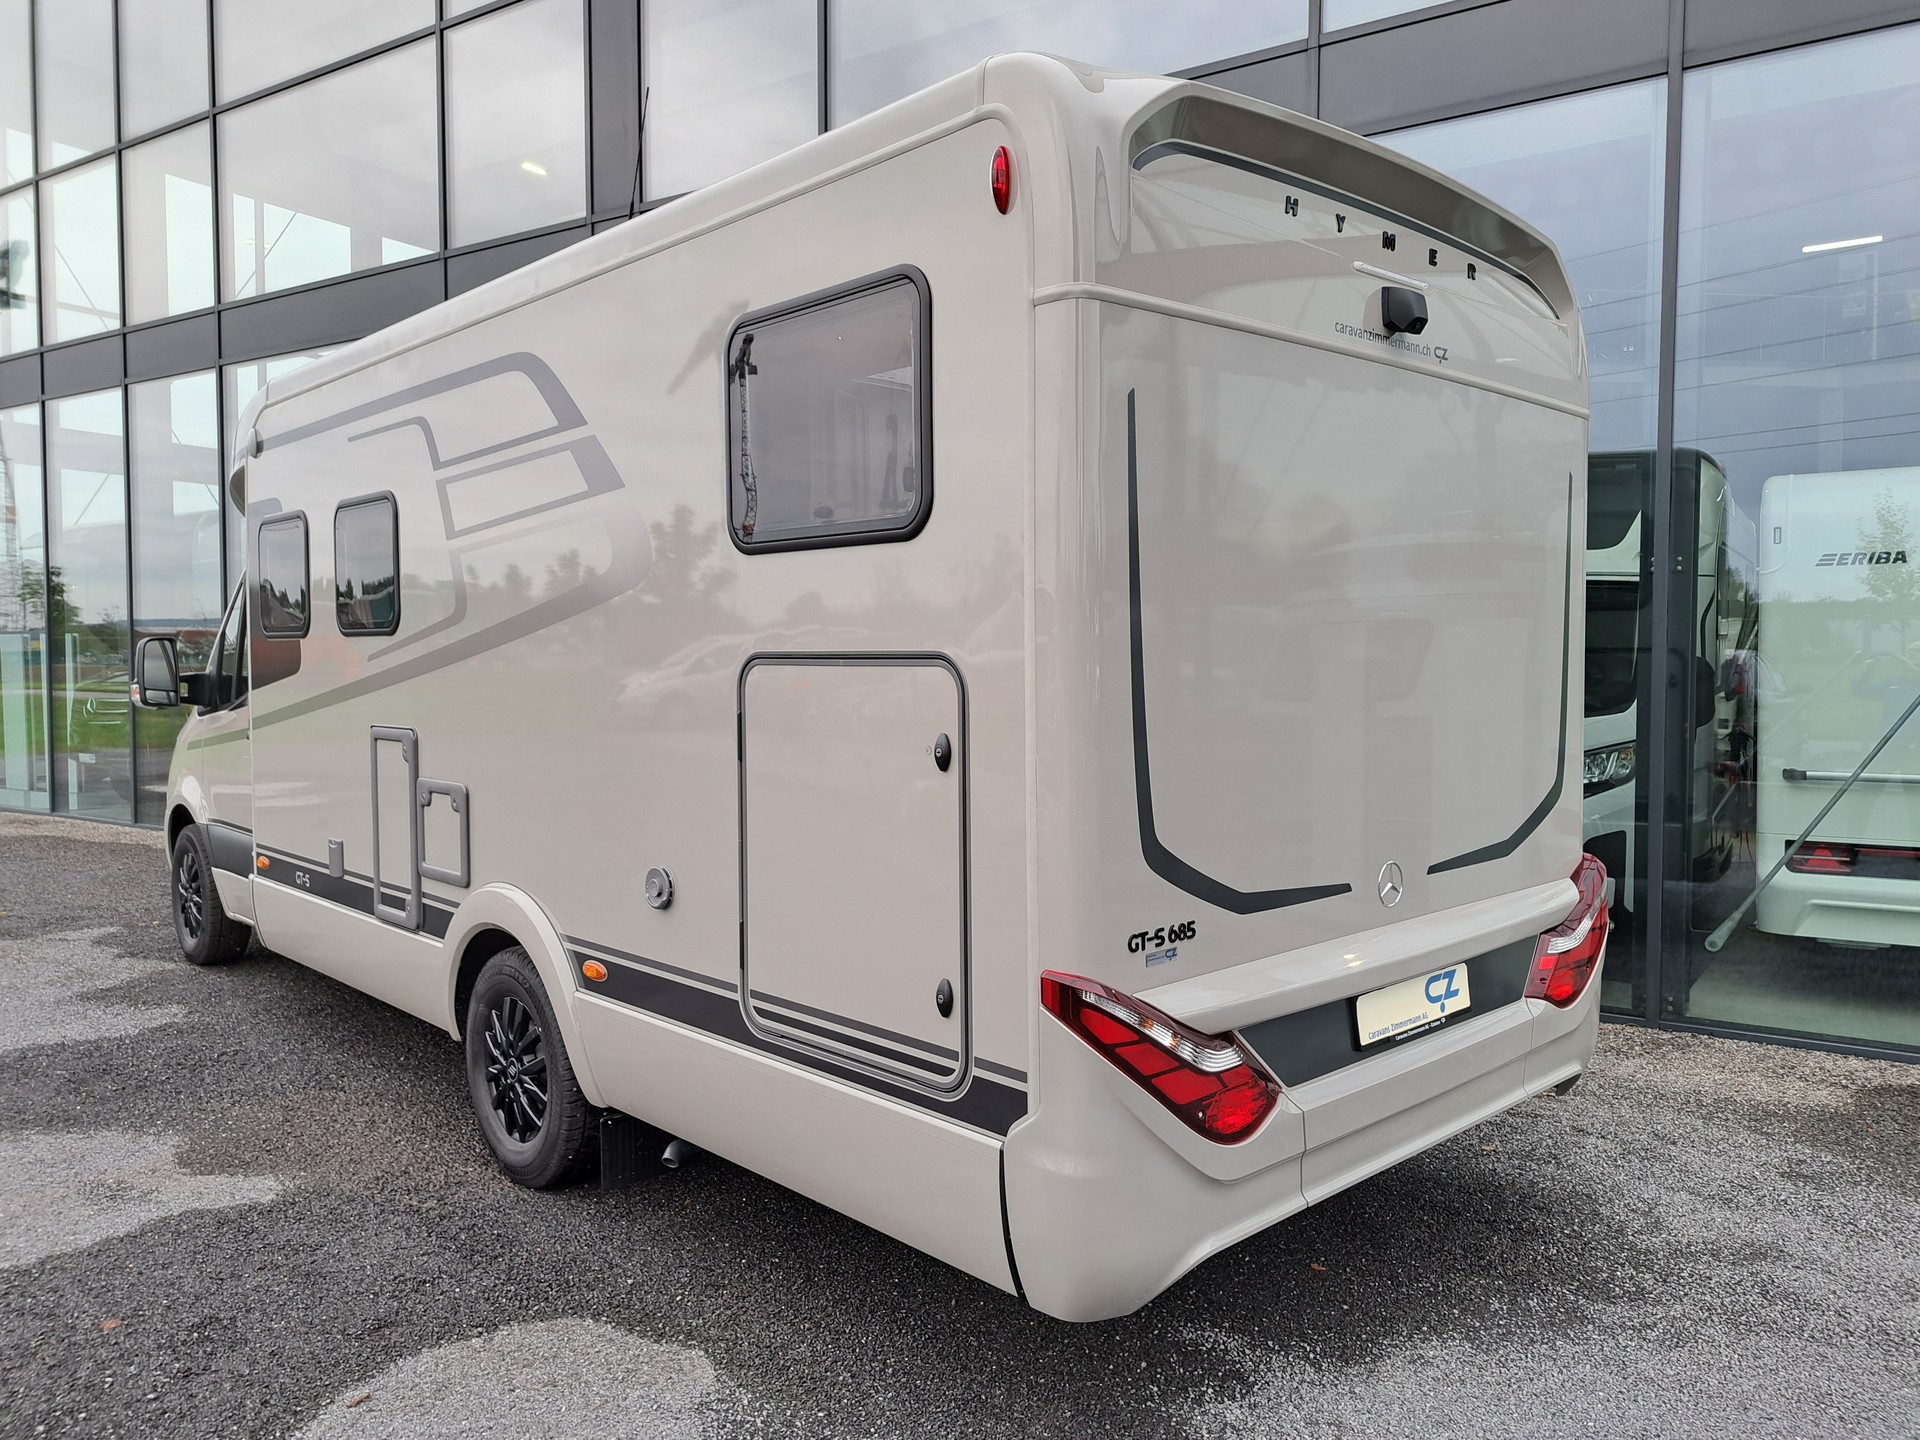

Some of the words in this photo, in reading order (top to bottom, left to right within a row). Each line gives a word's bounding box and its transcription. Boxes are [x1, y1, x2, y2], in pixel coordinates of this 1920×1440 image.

[1285, 195, 1477, 281] HYMER
[1334, 321, 1431, 357] caravanzimmermann.ch
[1834, 550, 1908, 567] ERIBA
[295, 870, 311, 888] GT-S
[1127, 927, 1165, 953] GT-S
[1167, 920, 1197, 944] 685
[1368, 1026, 1391, 1040] Caravans
[1391, 1015, 1422, 1031] Zimmermann
